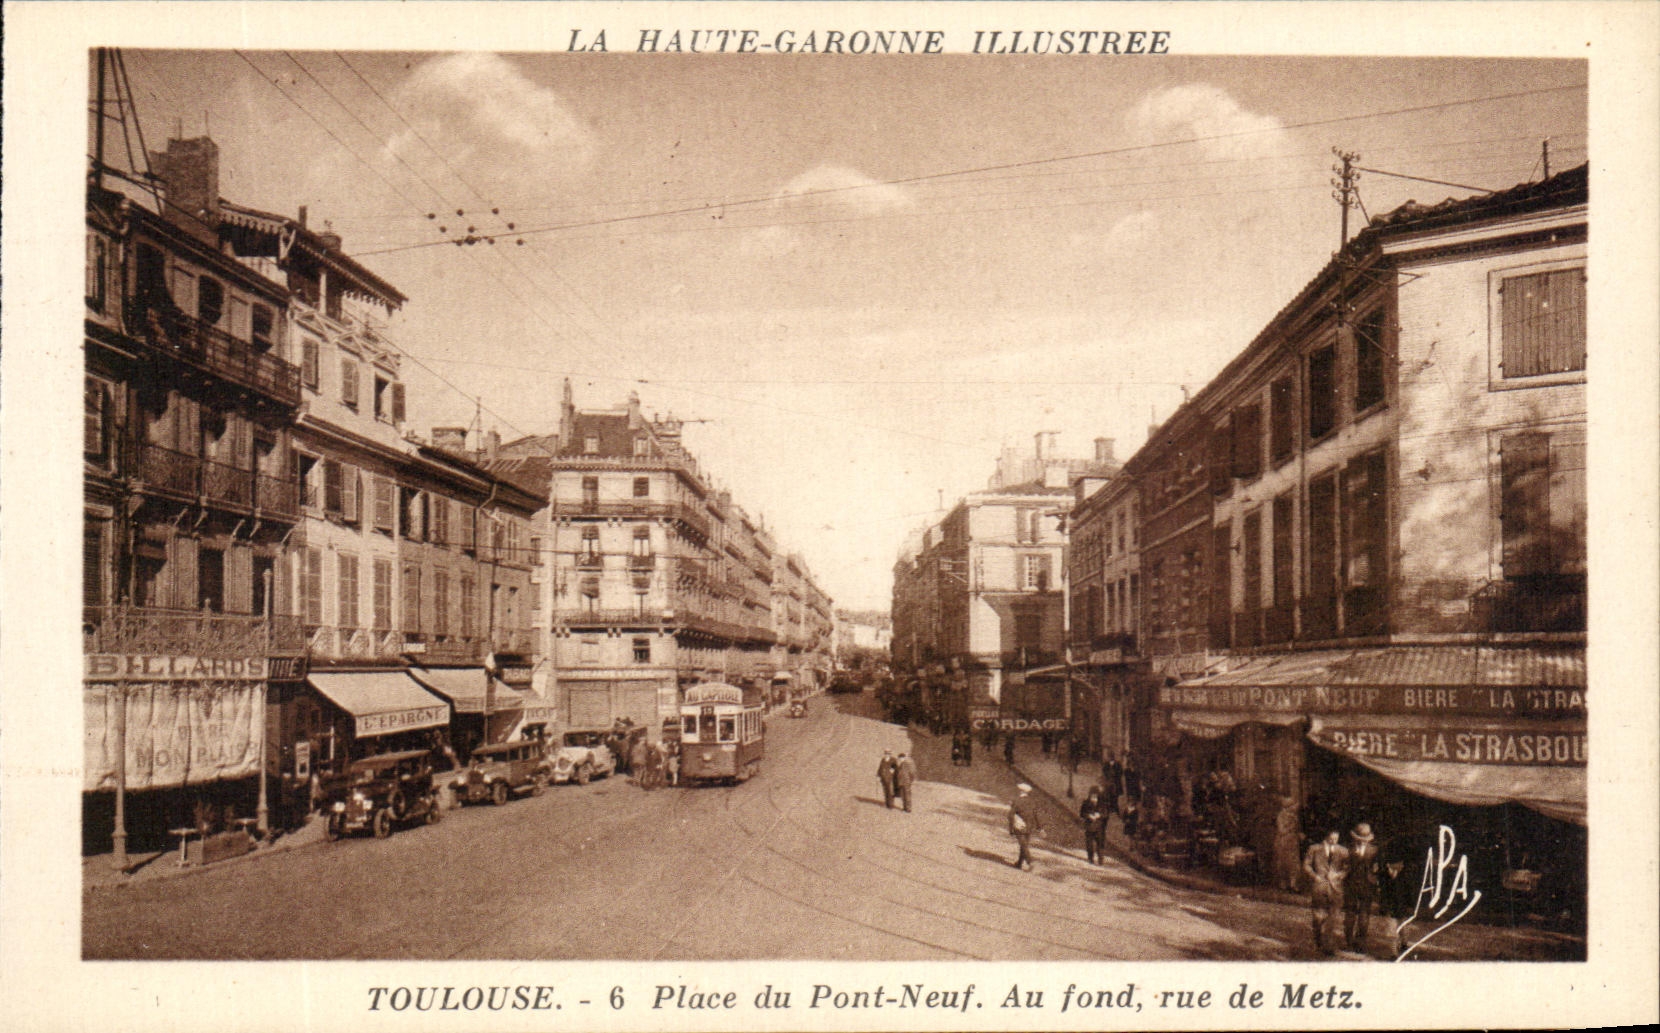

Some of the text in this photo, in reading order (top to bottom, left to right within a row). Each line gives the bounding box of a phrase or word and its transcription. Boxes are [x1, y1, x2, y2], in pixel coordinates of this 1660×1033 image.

[88, 656, 265, 676] BILLARDS
[1250, 688, 1307, 707] PONT
[1404, 689, 1458, 708] BIERE
[972, 719, 1070, 730] CORDAGE
